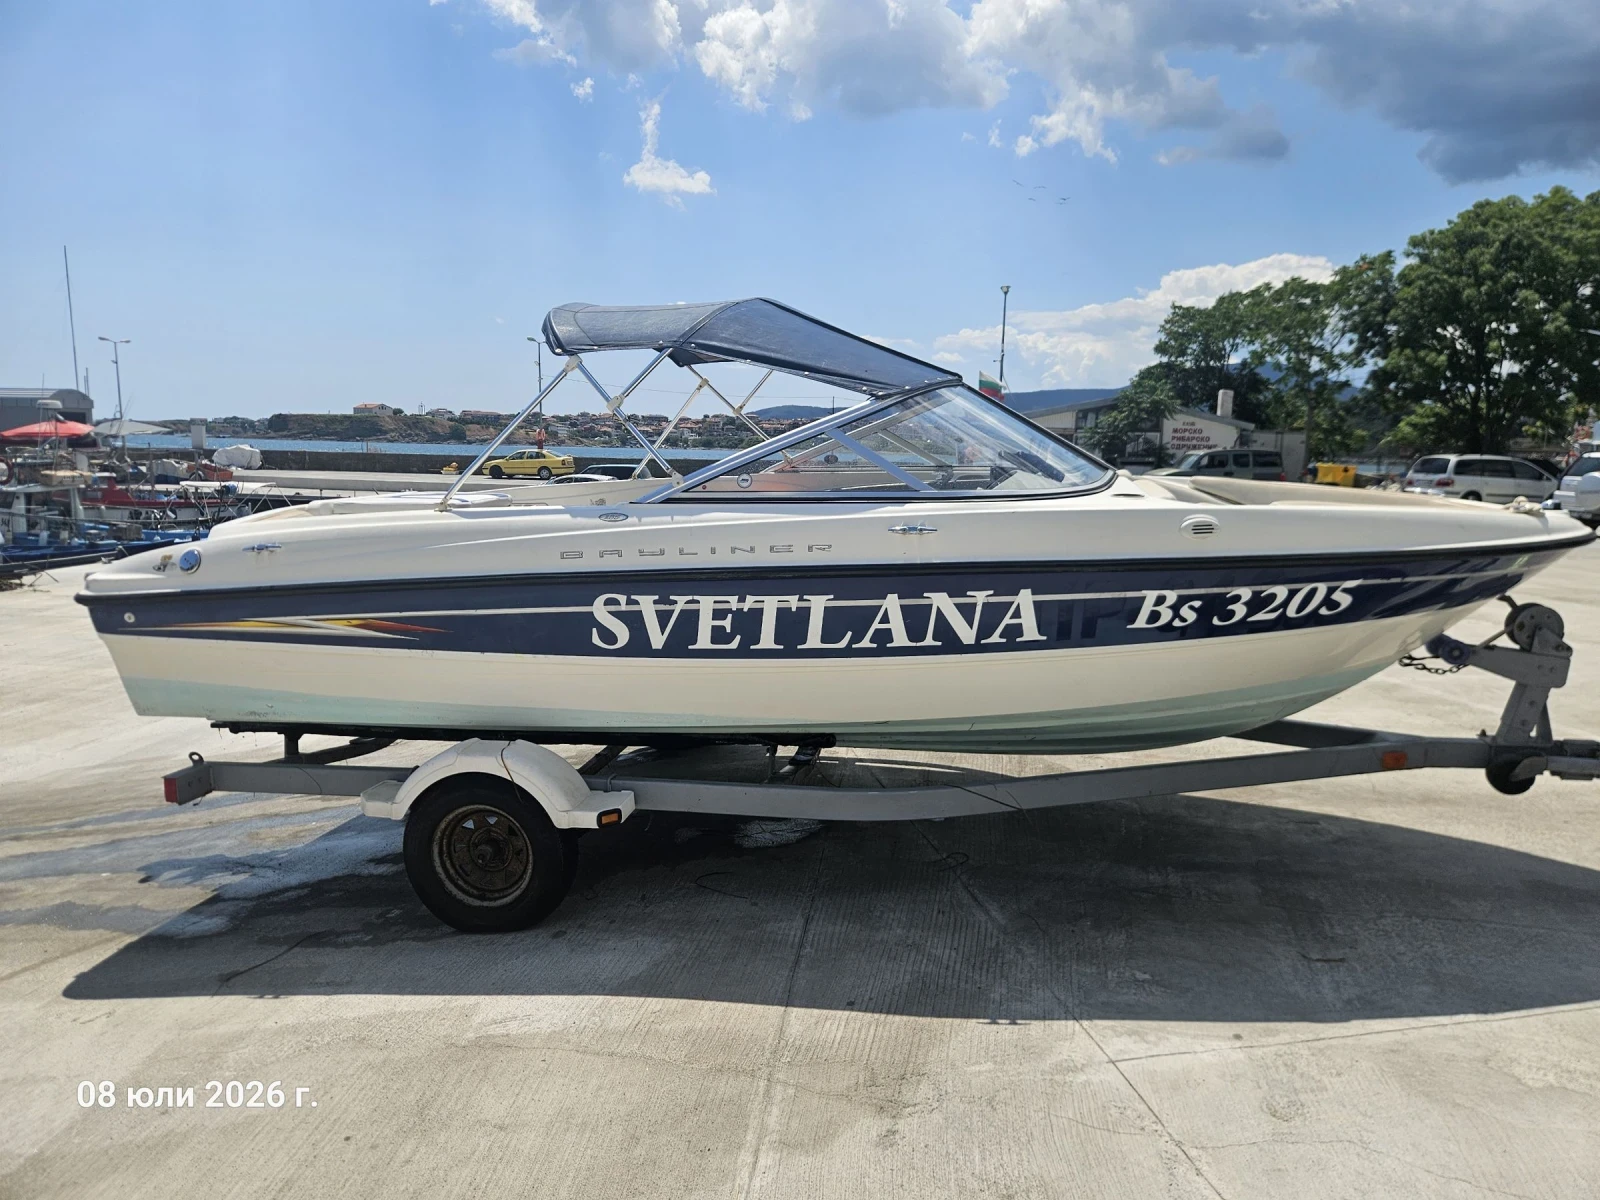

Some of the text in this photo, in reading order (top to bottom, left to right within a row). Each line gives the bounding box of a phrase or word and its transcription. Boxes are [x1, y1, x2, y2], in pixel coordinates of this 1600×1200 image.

[560, 543, 833, 560] BAYLINER
[591, 588, 1047, 650] SVETLANA
[1126, 589, 1202, 629] Bs
[1212, 578, 1364, 627] 3205
